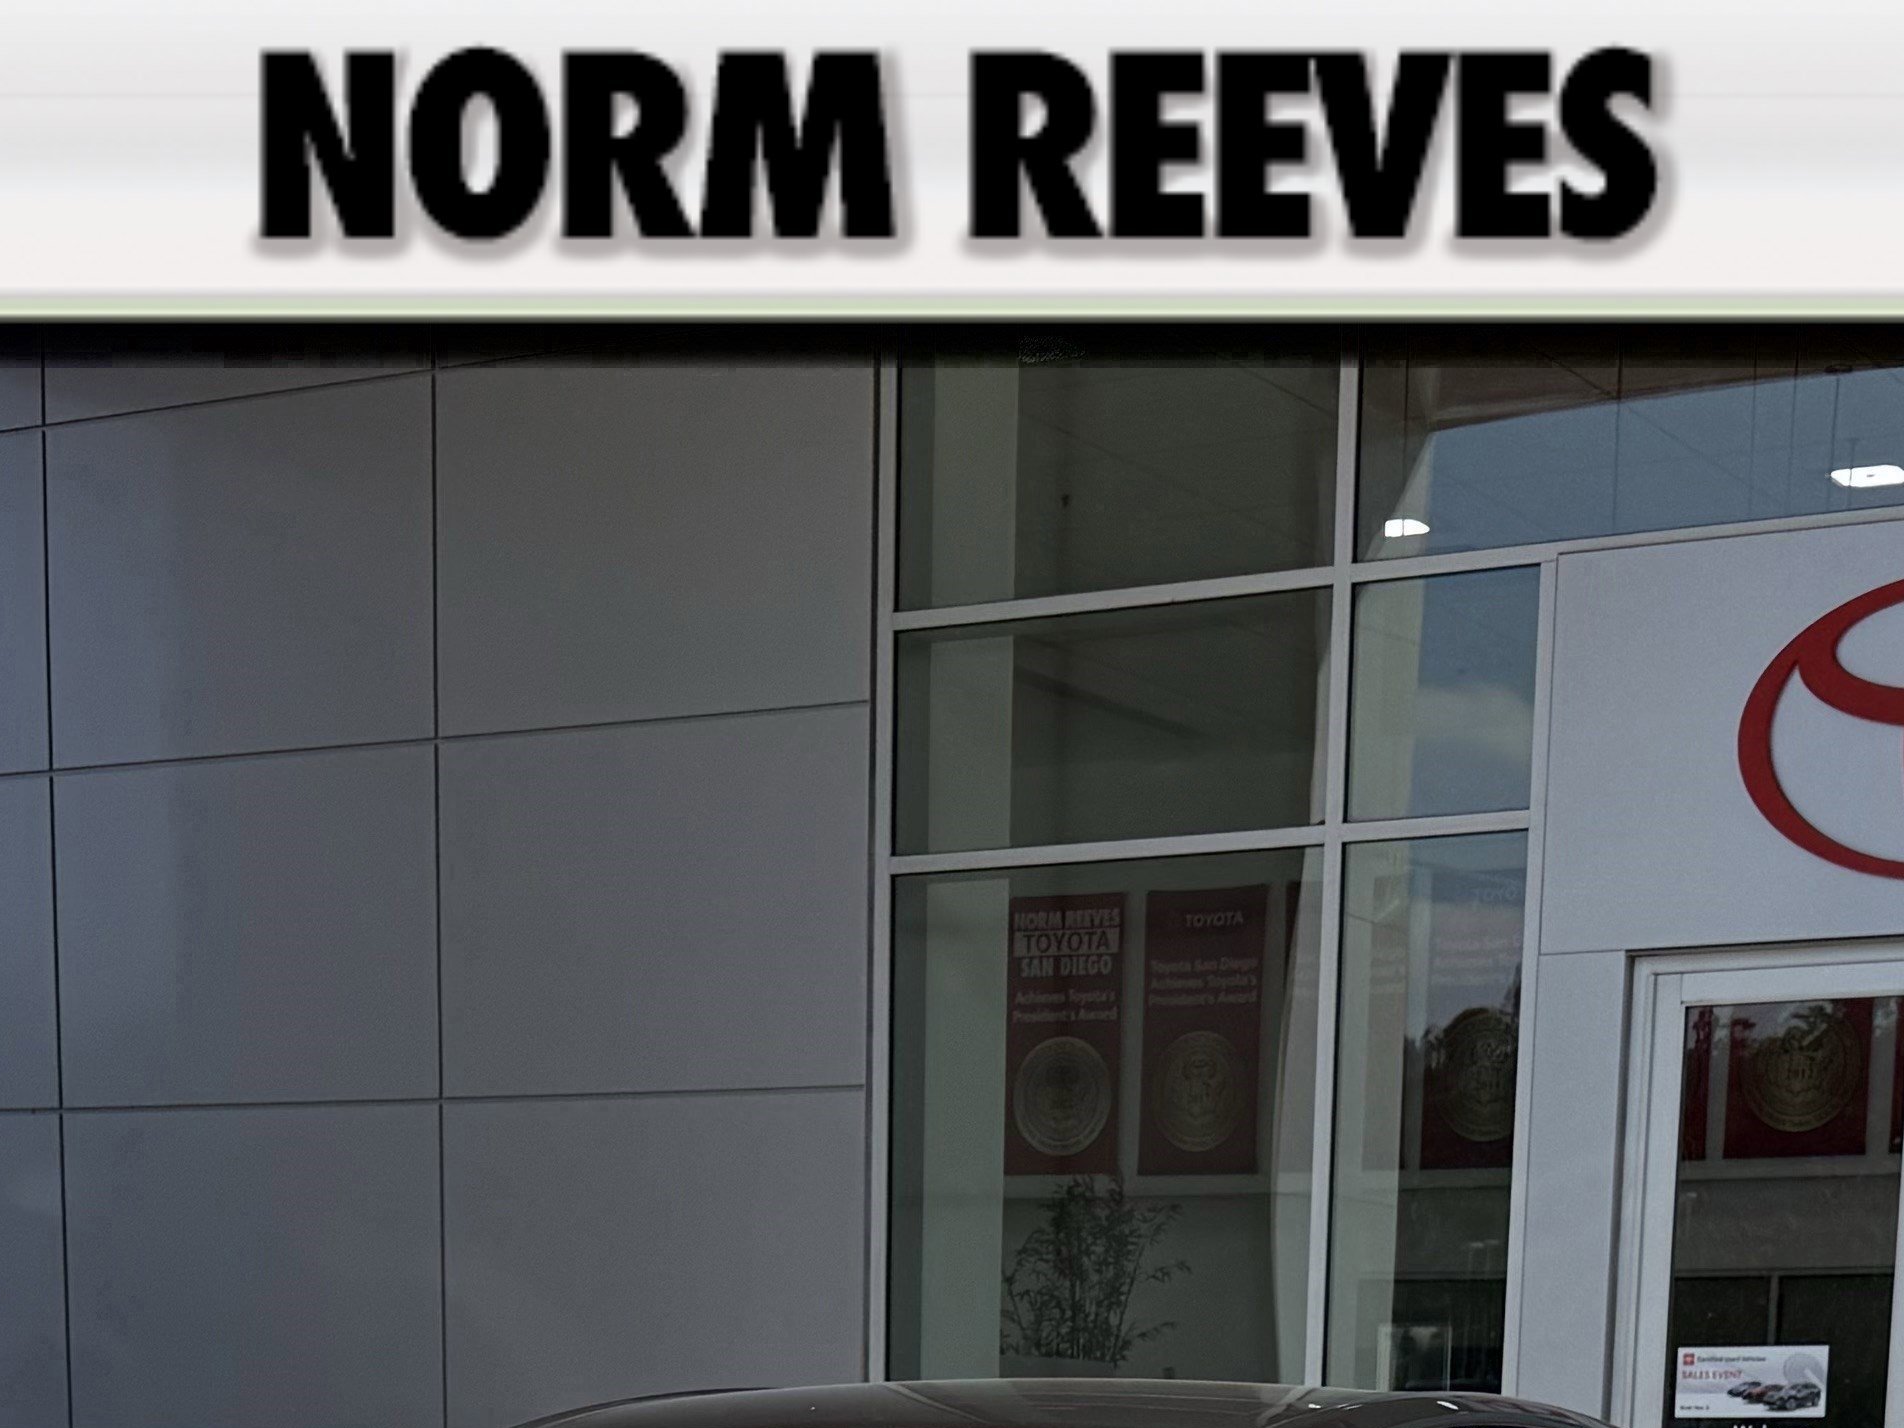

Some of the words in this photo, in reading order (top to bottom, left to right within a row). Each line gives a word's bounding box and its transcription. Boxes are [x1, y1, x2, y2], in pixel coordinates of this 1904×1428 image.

[1014, 911, 1063, 930] NORM
[1065, 908, 1120, 929] REEVES
[1184, 911, 1244, 928] TOYOTA
[1023, 931, 1111, 954] TOYOTA
[1020, 957, 1054, 977] SAN
[1060, 955, 1113, 976] DIEGO
